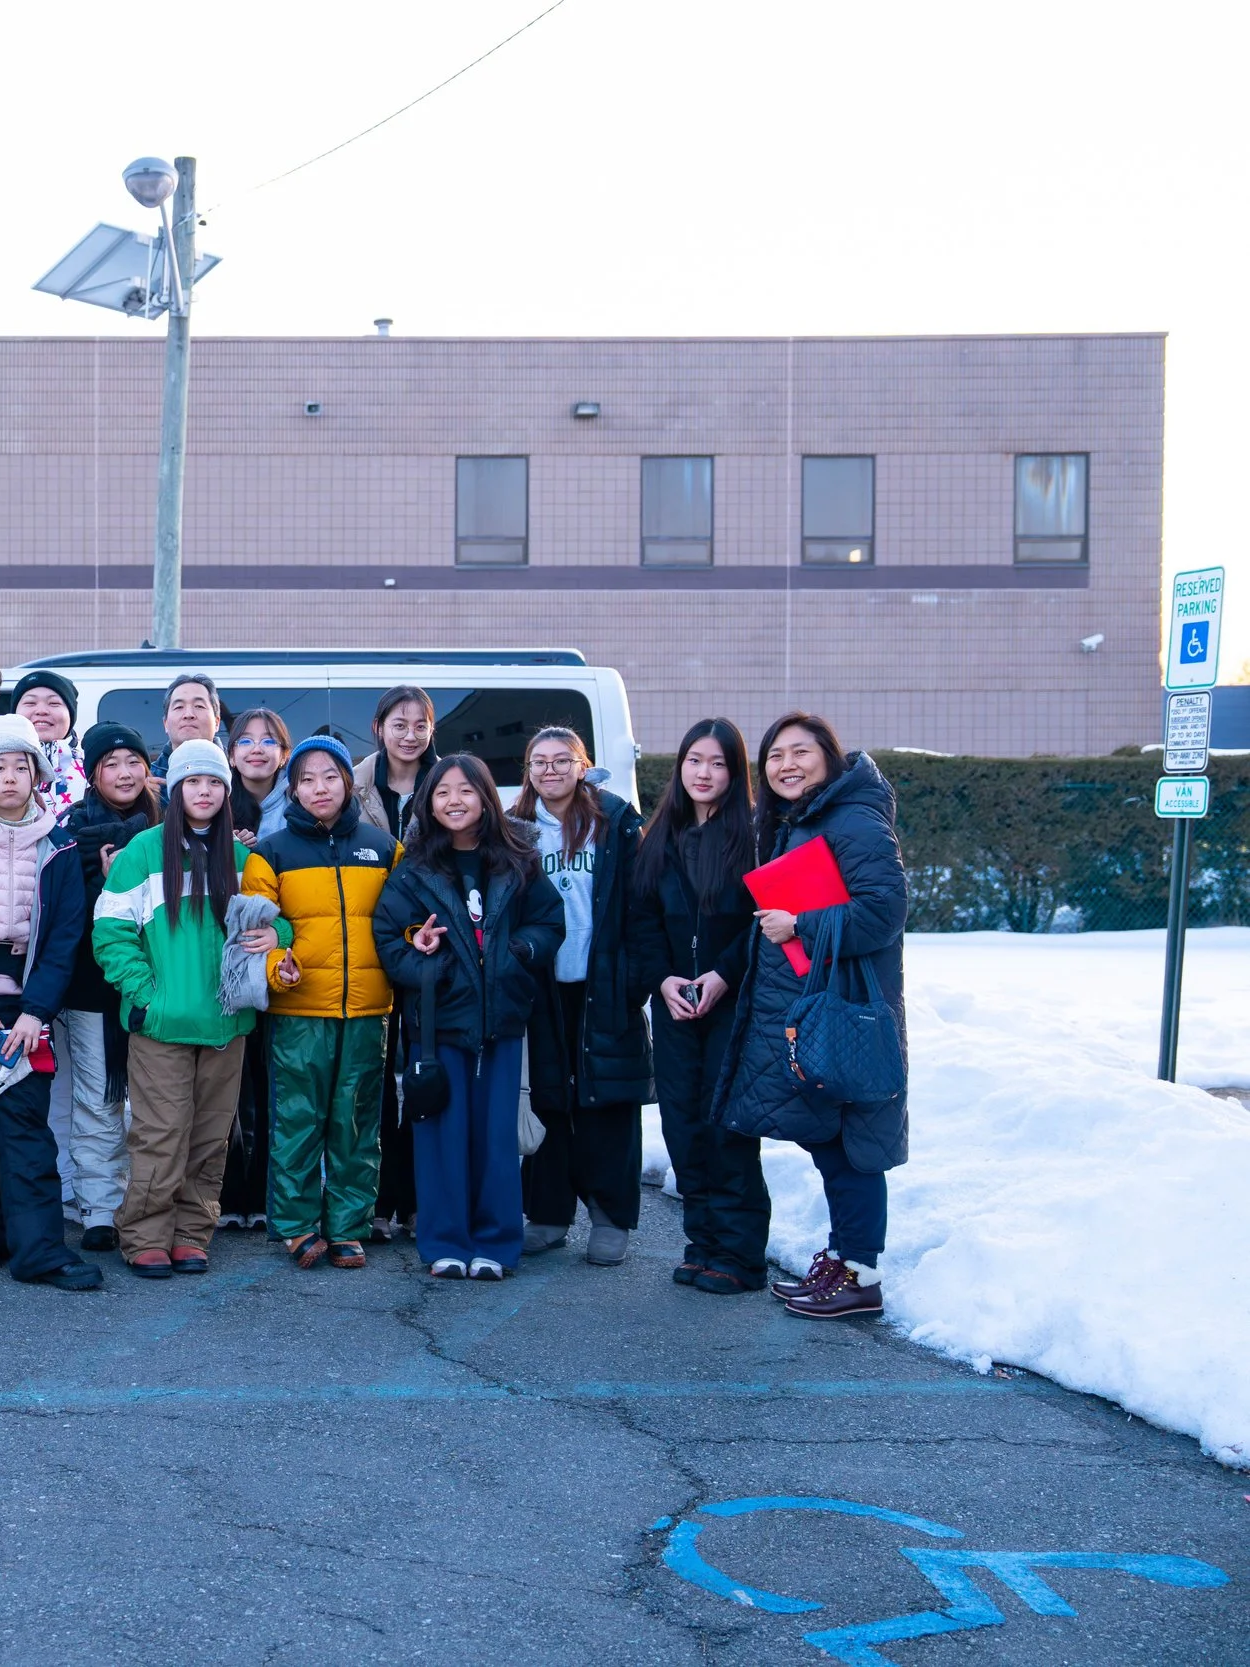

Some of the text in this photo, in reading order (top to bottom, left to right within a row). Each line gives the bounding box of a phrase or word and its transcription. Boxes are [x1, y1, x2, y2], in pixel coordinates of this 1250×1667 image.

[1175, 577, 1221, 597] RESERVED
[1177, 598, 1217, 617] PARKING
[1176, 697, 1203, 705] PENALTY
[1191, 751, 1204, 759] ZONE
[1175, 786, 1193, 797] VAN
[1165, 800, 1199, 808] ACCESSIBLE
